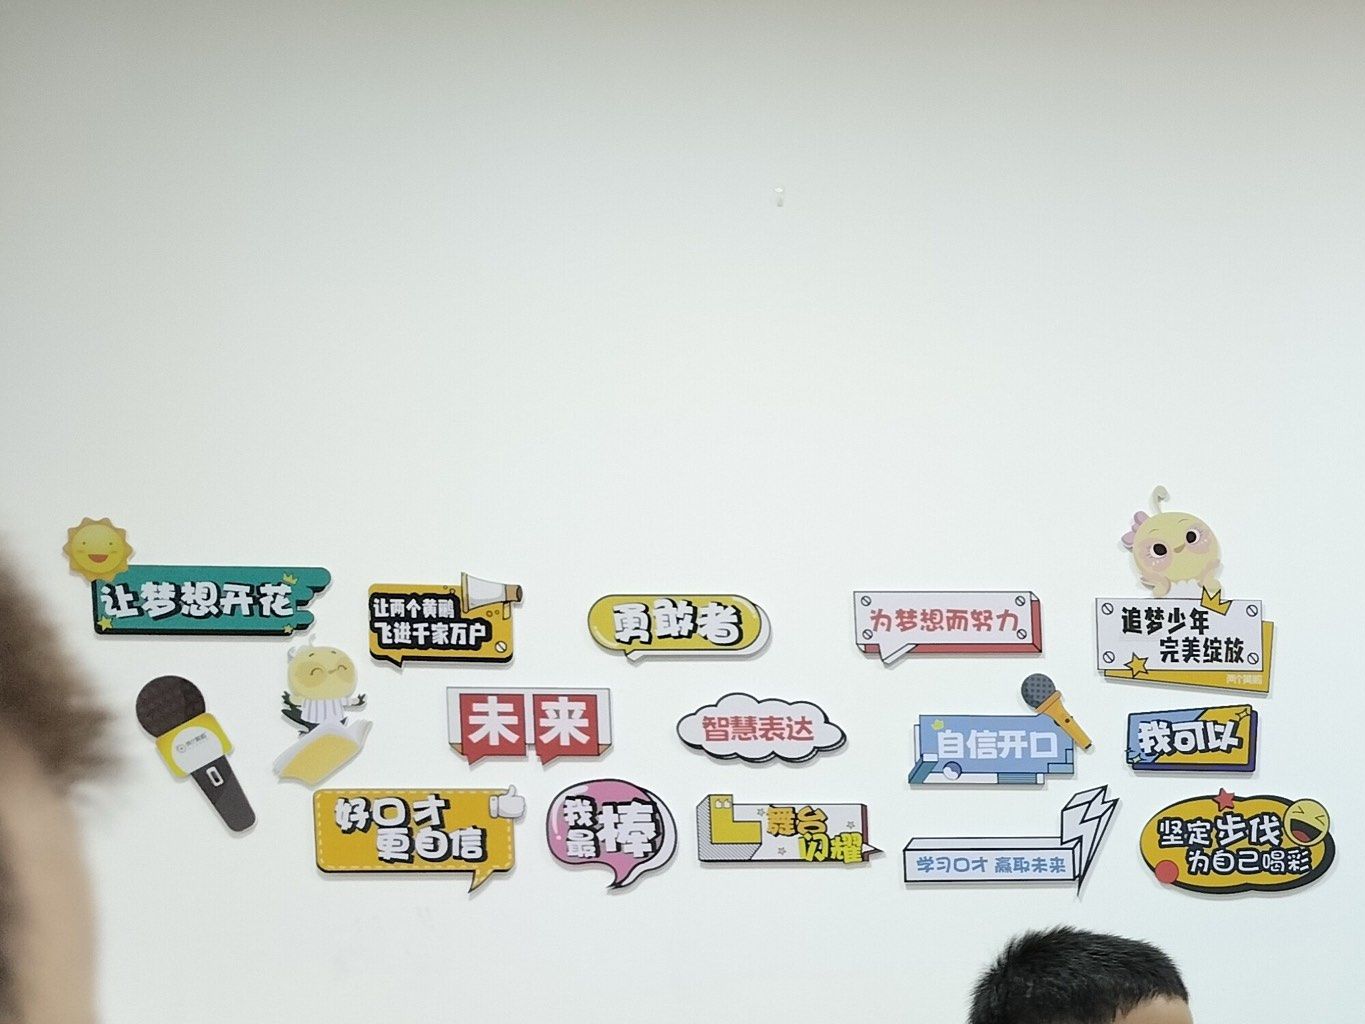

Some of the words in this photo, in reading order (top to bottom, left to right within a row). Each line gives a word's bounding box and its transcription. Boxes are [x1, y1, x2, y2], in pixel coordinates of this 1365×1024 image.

[100, 581, 295, 620] 让梦想开花
[374, 621, 486, 645] 飞进千家万户
[613, 598, 742, 645] 勇敢者
[869, 608, 1020, 634] 为梦想而努力
[1121, 606, 1210, 635] 追梦少年
[1159, 636, 1245, 664] 完美绽放
[468, 696, 590, 745] 未来
[702, 715, 815, 742] 智慧表达
[1138, 719, 1241, 754] 我可以
[937, 728, 1058, 760] 自信开口
[335, 796, 448, 831] 好口才
[766, 806, 828, 836] 舞台
[1158, 812, 1282, 846] 坚定步伐
[376, 826, 486, 862] 更自信
[799, 832, 864, 864] 闪耀
[916, 856, 988, 873] 学习口才
[994, 856, 1066, 873] 赢取未来
[1187, 847, 1313, 876] 为自己喝彩
